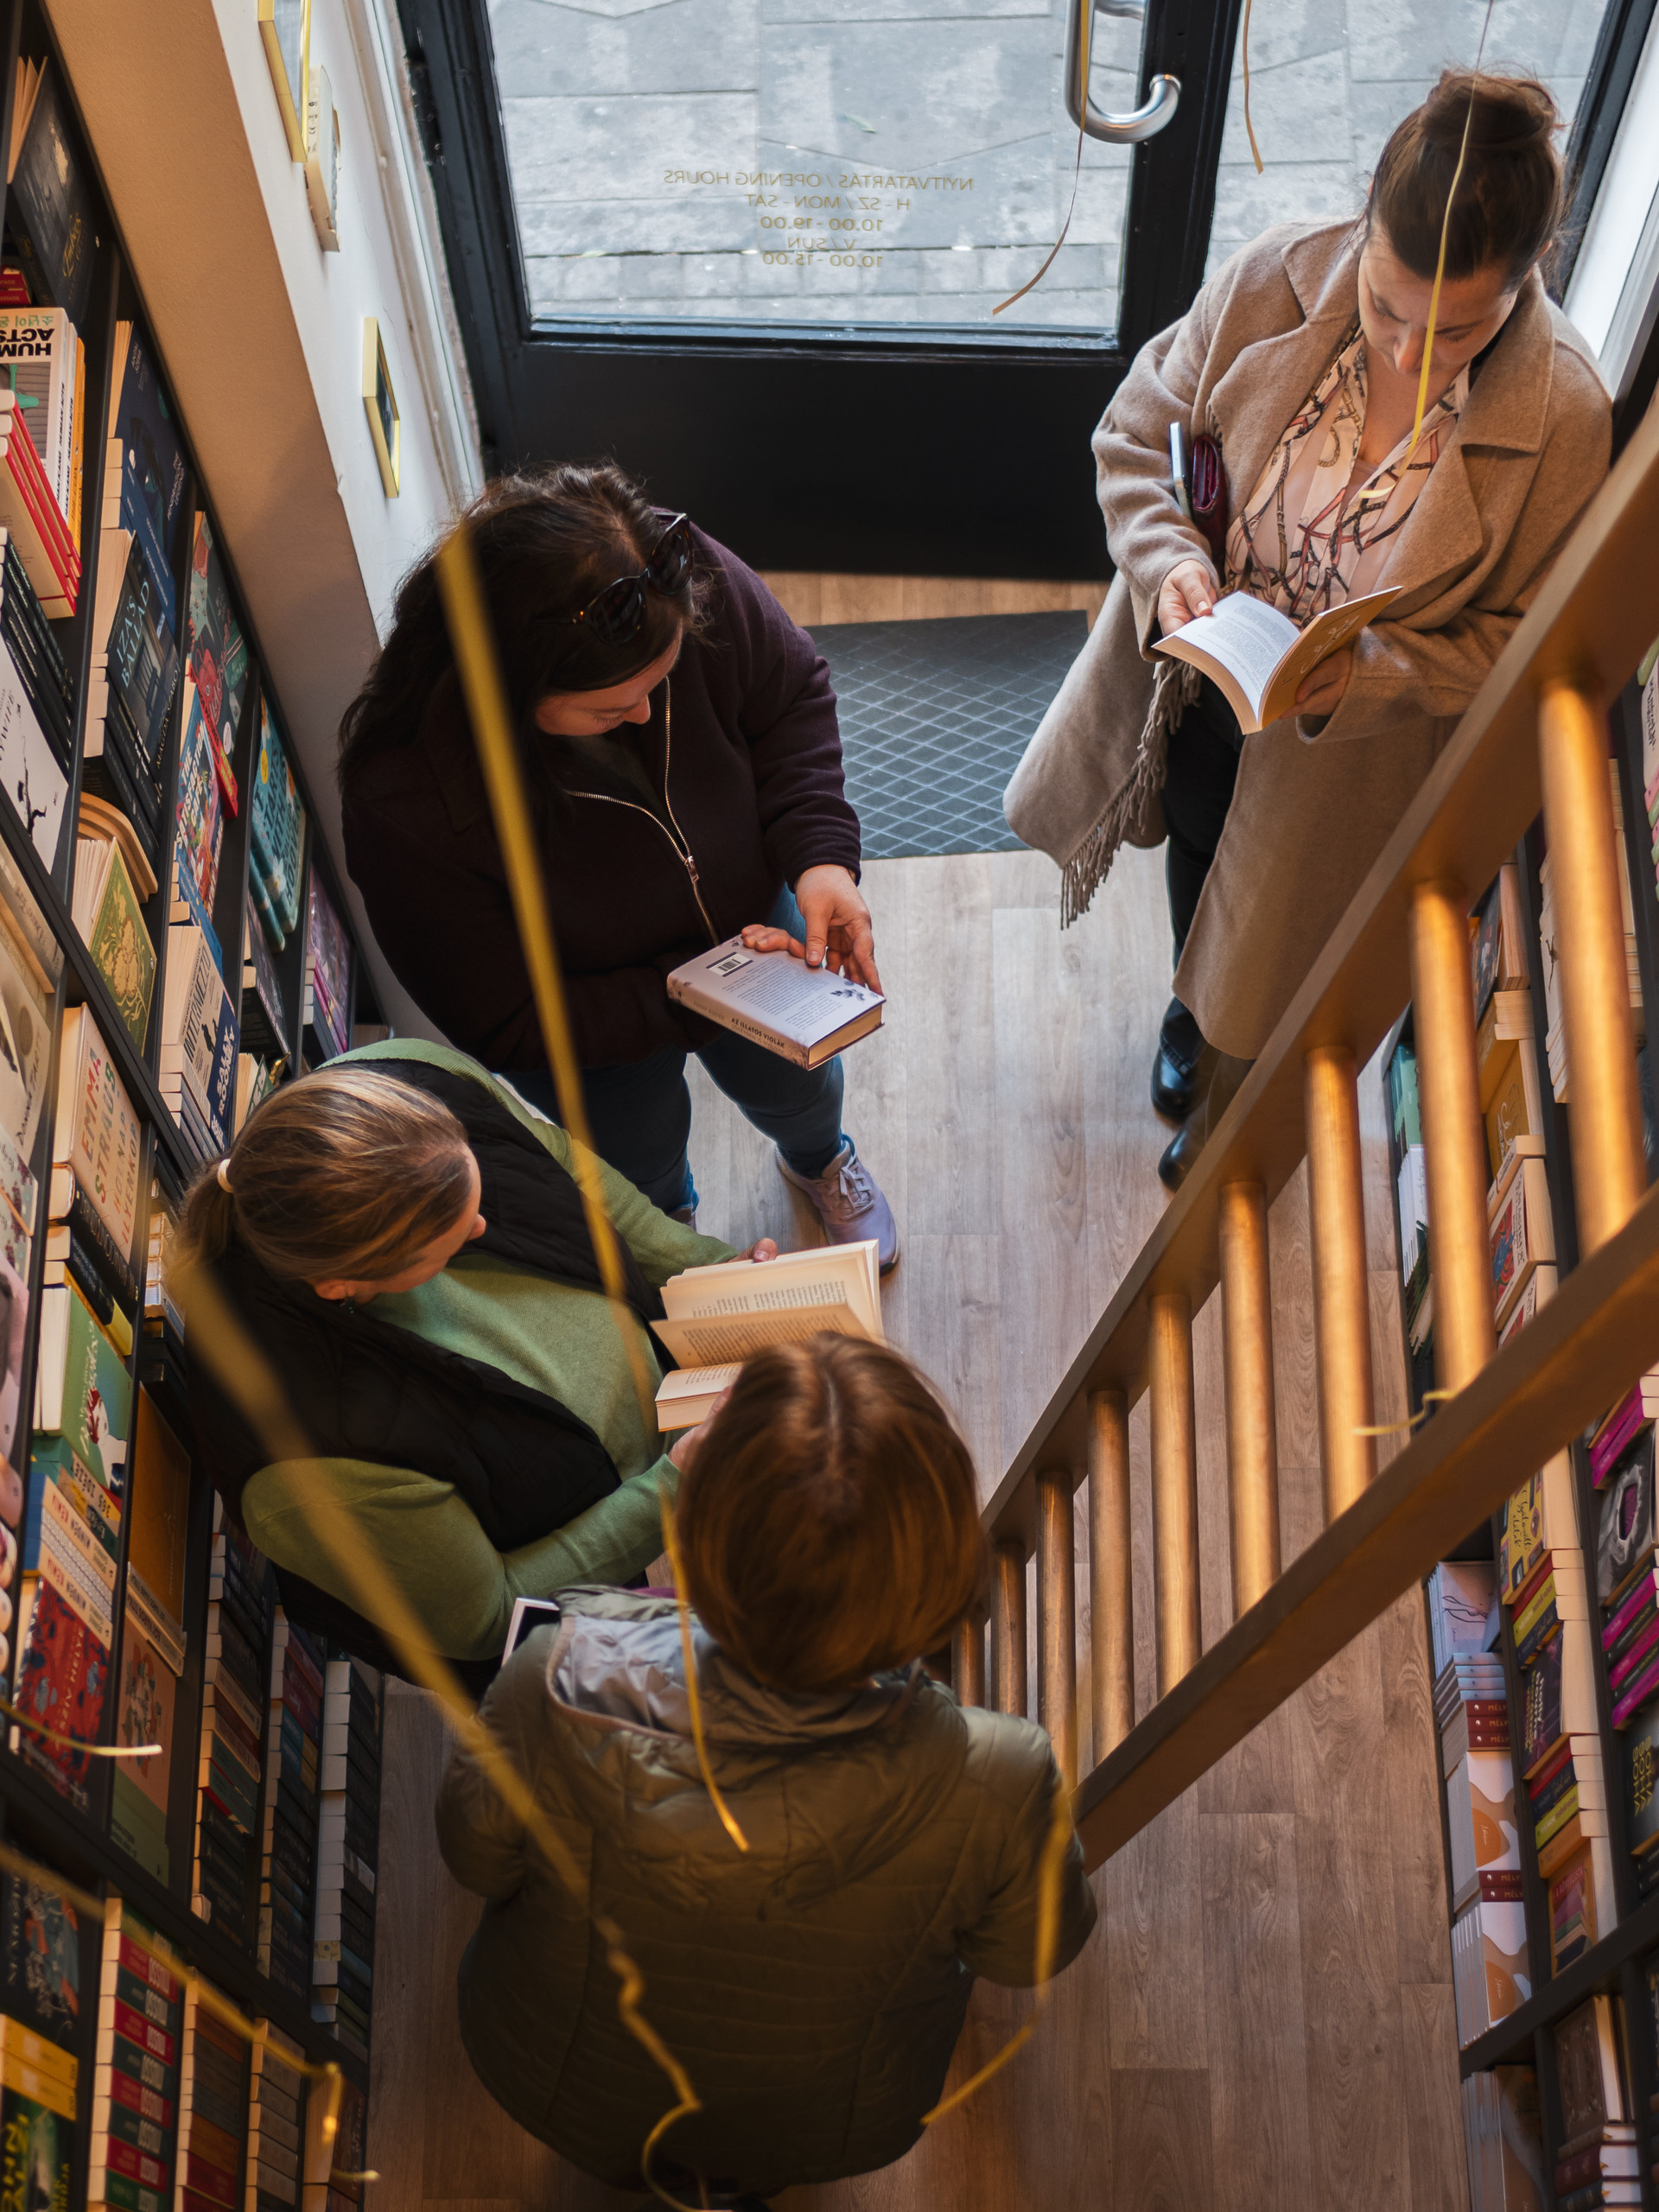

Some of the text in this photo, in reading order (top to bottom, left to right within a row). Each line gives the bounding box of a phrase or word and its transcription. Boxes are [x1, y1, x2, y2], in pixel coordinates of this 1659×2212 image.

[116, 595, 136, 664] IZA'S
[122, 581, 149, 689] BALLAD
[175, 719, 206, 849] SATISFACTION
[181, 746, 193, 785] THE
[183, 944, 212, 1064] INTERMEZZO
[731, 1017, 739, 1026] AZ
[741, 1021, 762, 1037] ILLATOS
[80, 1046, 102, 1163] EMMA
[217, 1025, 231, 1096] SALLY
[219, 1025, 236, 1117] ROONEY
[95, 1061, 117, 1204] STRAUB
[122, 1122, 138, 1245] ILYENKOR
